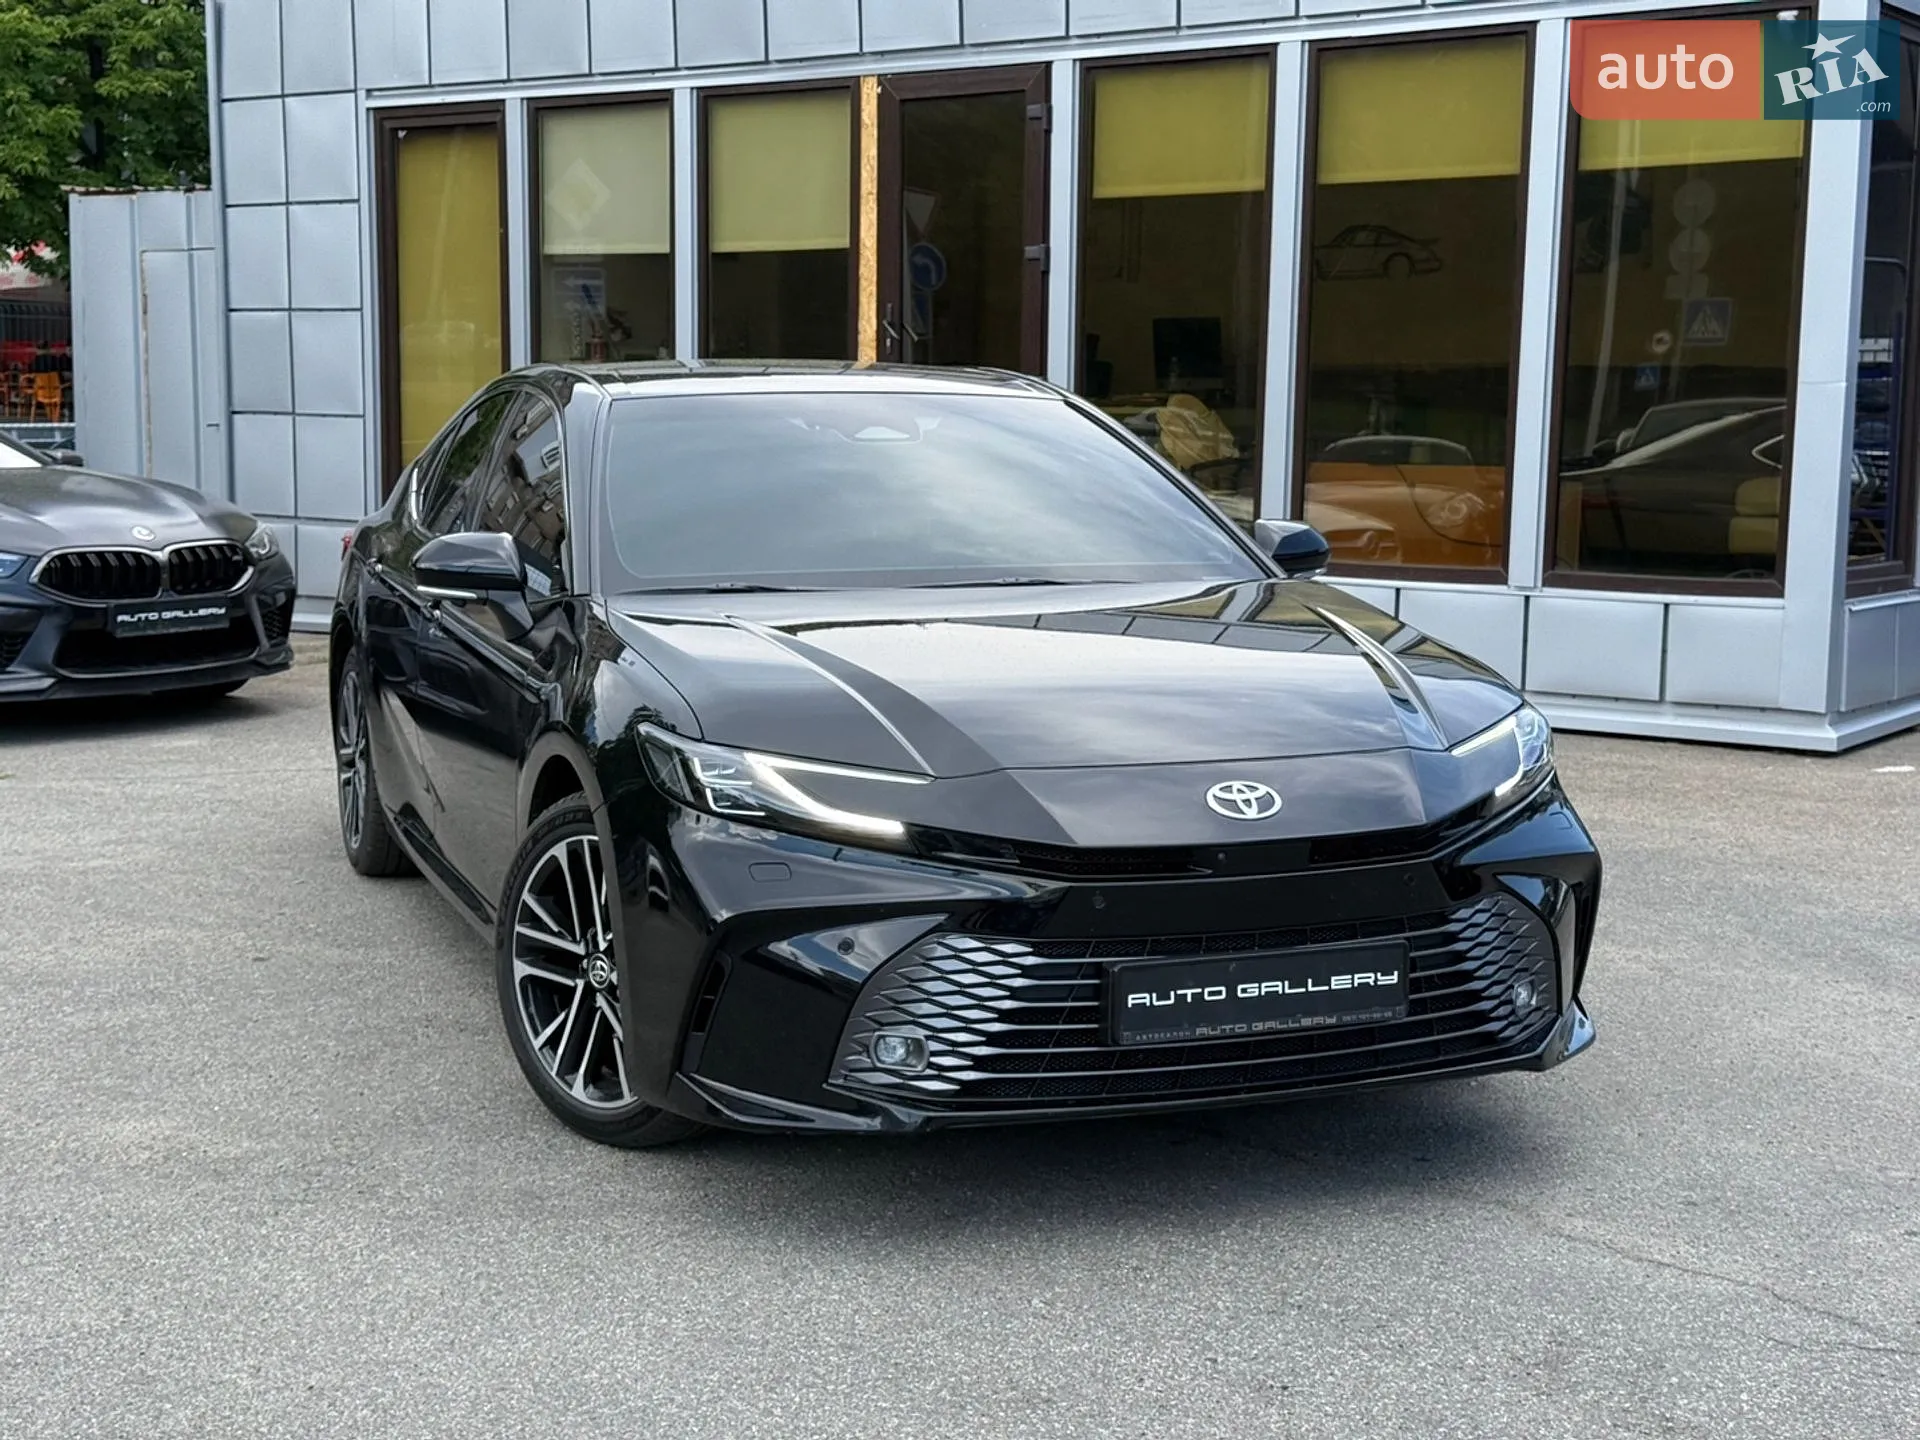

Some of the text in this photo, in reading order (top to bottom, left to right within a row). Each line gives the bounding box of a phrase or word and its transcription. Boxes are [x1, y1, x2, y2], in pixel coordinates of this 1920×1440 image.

[116, 607, 226, 623] AUTO GALLERY
[1127, 970, 1399, 1008] AUTO GALLERY
[1195, 1023, 1247, 1037] AUTO
[1251, 1015, 1337, 1031] GALLERY
